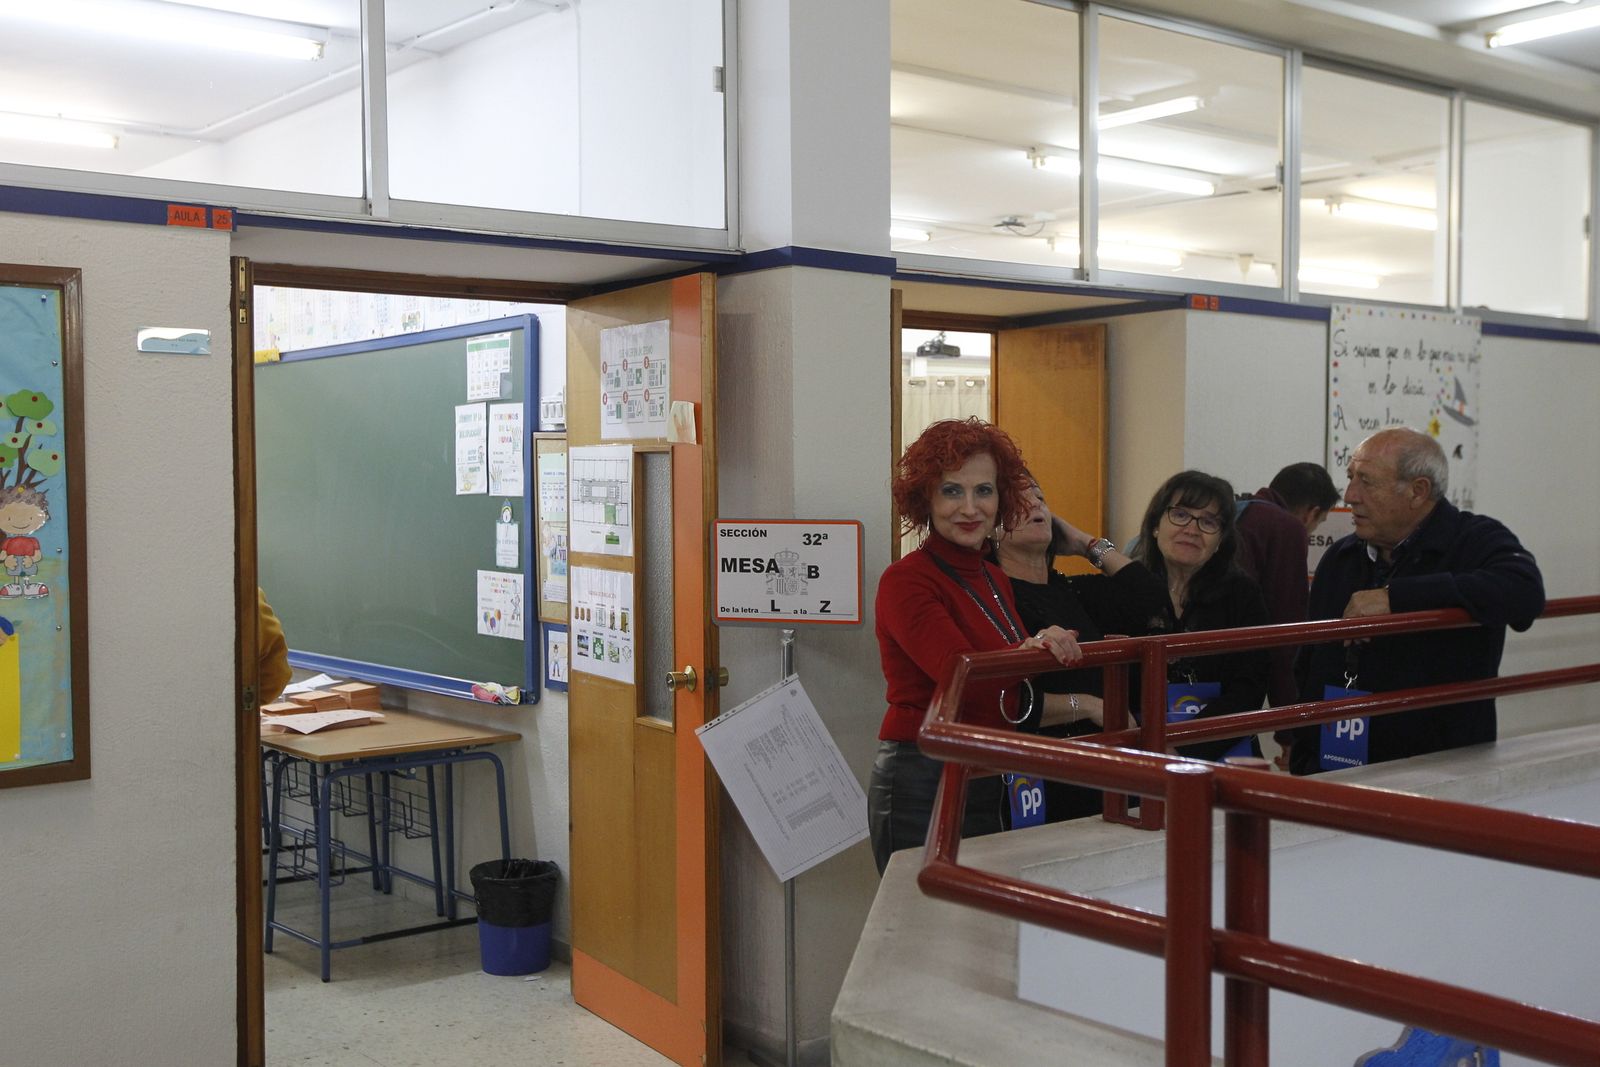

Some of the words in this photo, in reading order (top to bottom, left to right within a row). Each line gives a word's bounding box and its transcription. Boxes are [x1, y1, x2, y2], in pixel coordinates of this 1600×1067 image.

[174, 210, 200, 222] AULA
[216, 214, 228, 225] 25
[720, 528, 768, 538] SECCIÓN
[1308, 535, 1334, 547] ESA
[721, 557, 781, 574] MESA
[807, 565, 820, 579] B
[741, 606, 759, 614] letra
[770, 599, 781, 612] L
[819, 600, 831, 613] Z
[1336, 717, 1364, 741] pp
[1021, 787, 1043, 818] pp
